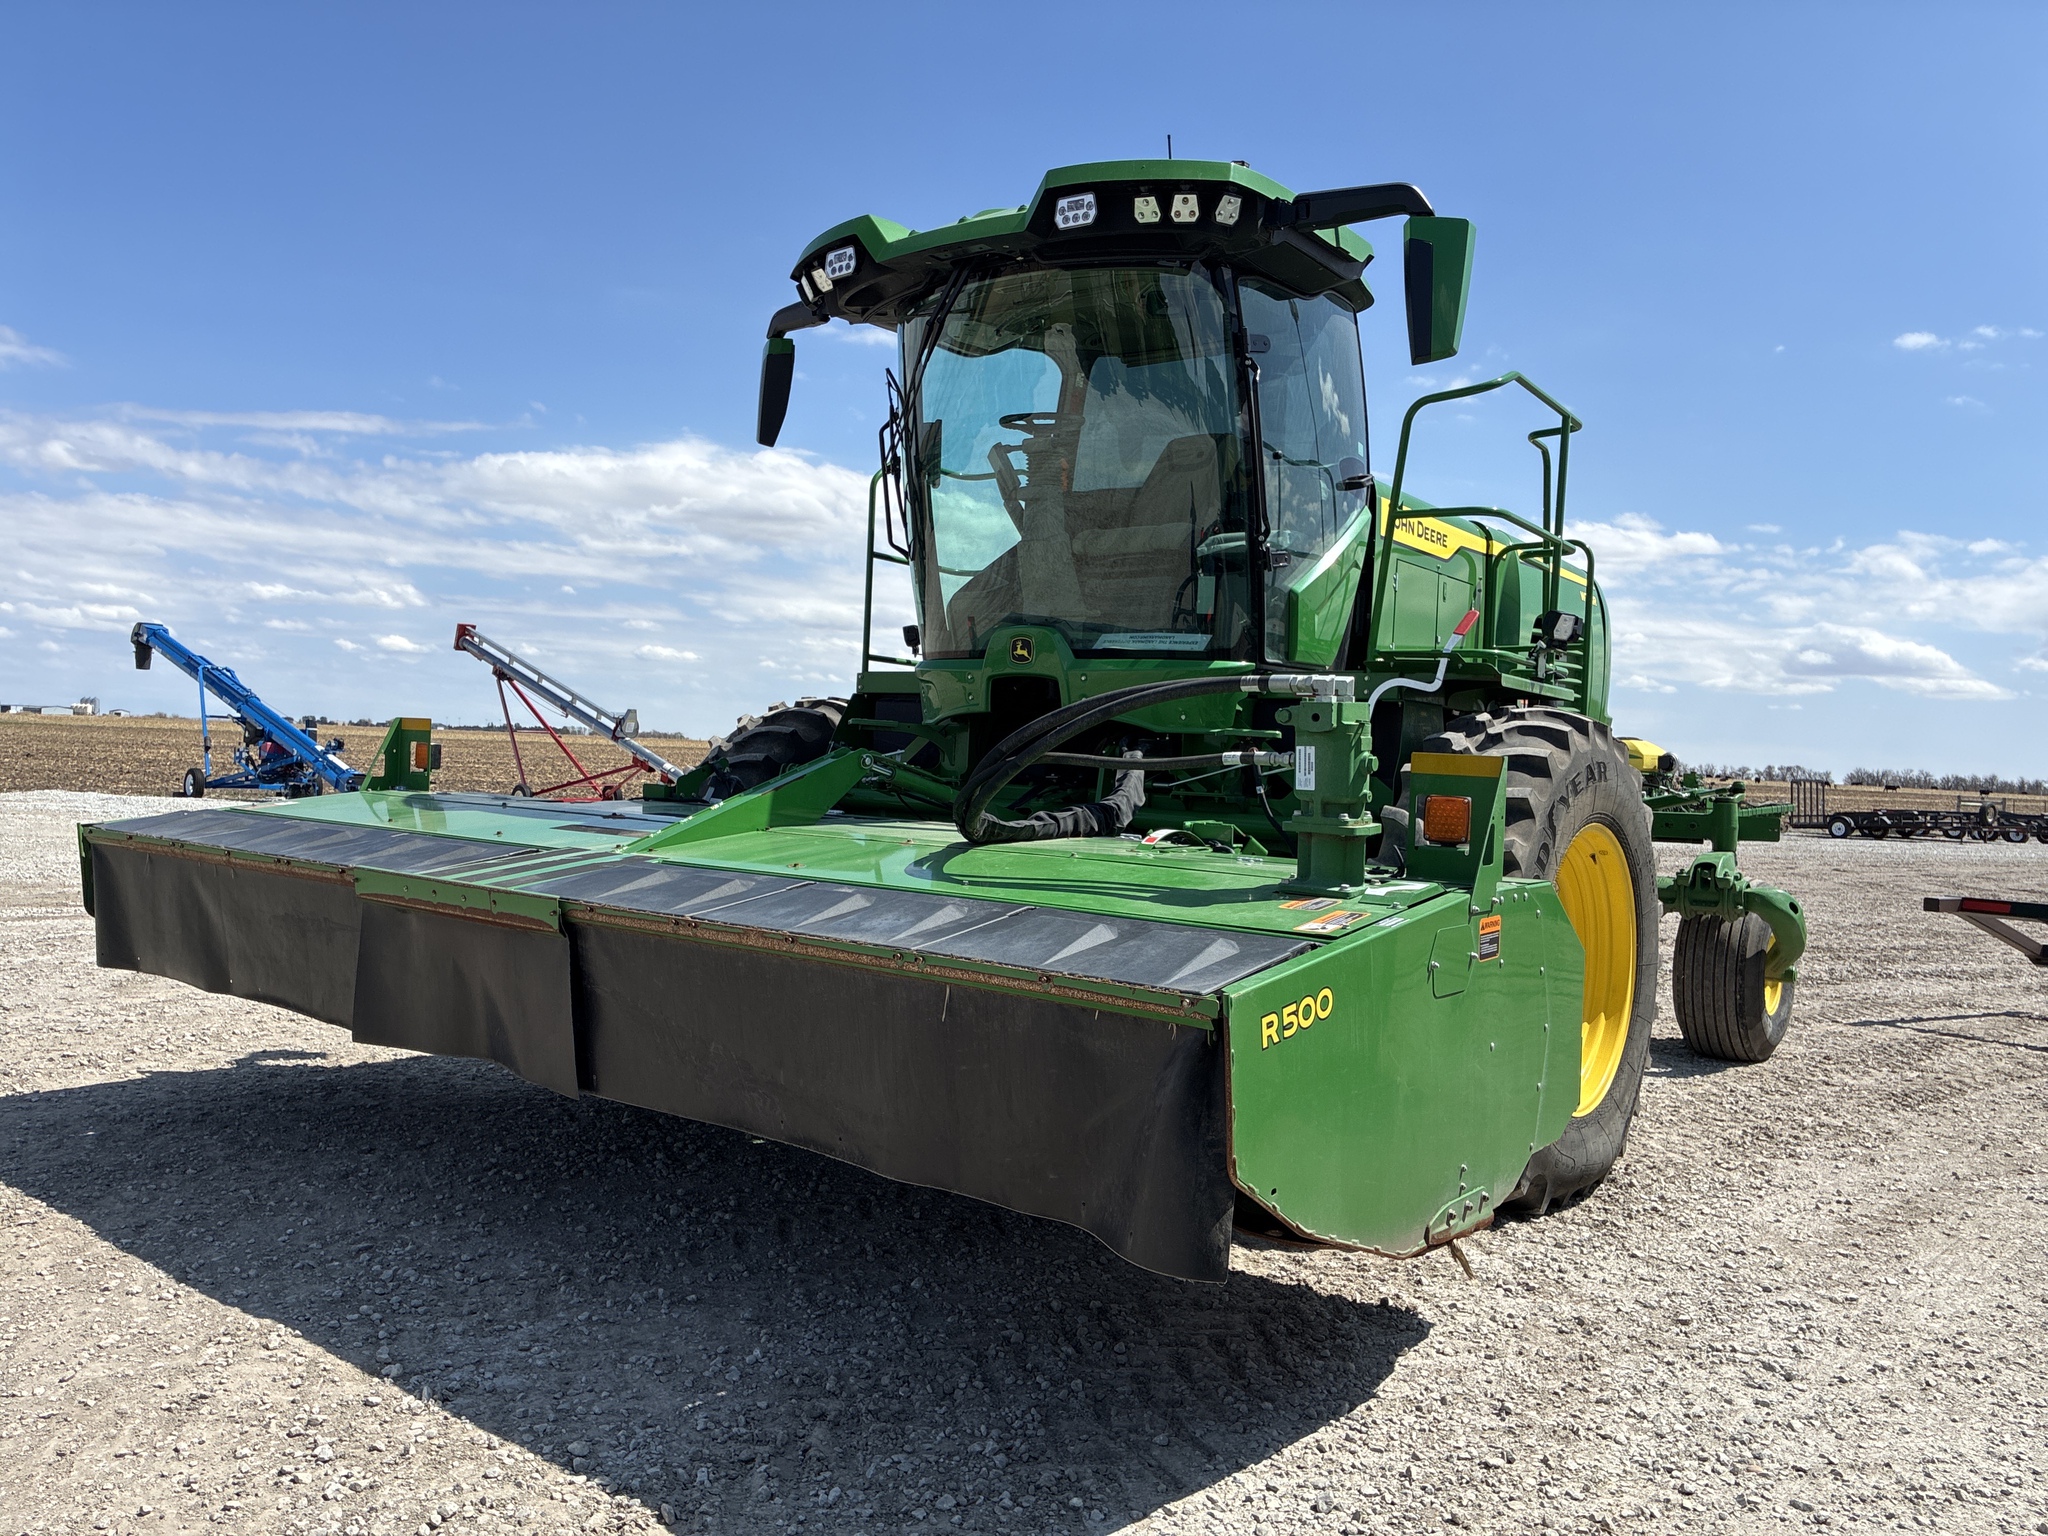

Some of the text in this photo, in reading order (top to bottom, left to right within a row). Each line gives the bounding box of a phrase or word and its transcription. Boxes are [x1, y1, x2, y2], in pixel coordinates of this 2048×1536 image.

[1394, 517, 1448, 549] OHN DEERE
[1261, 986, 1334, 1051] R500
